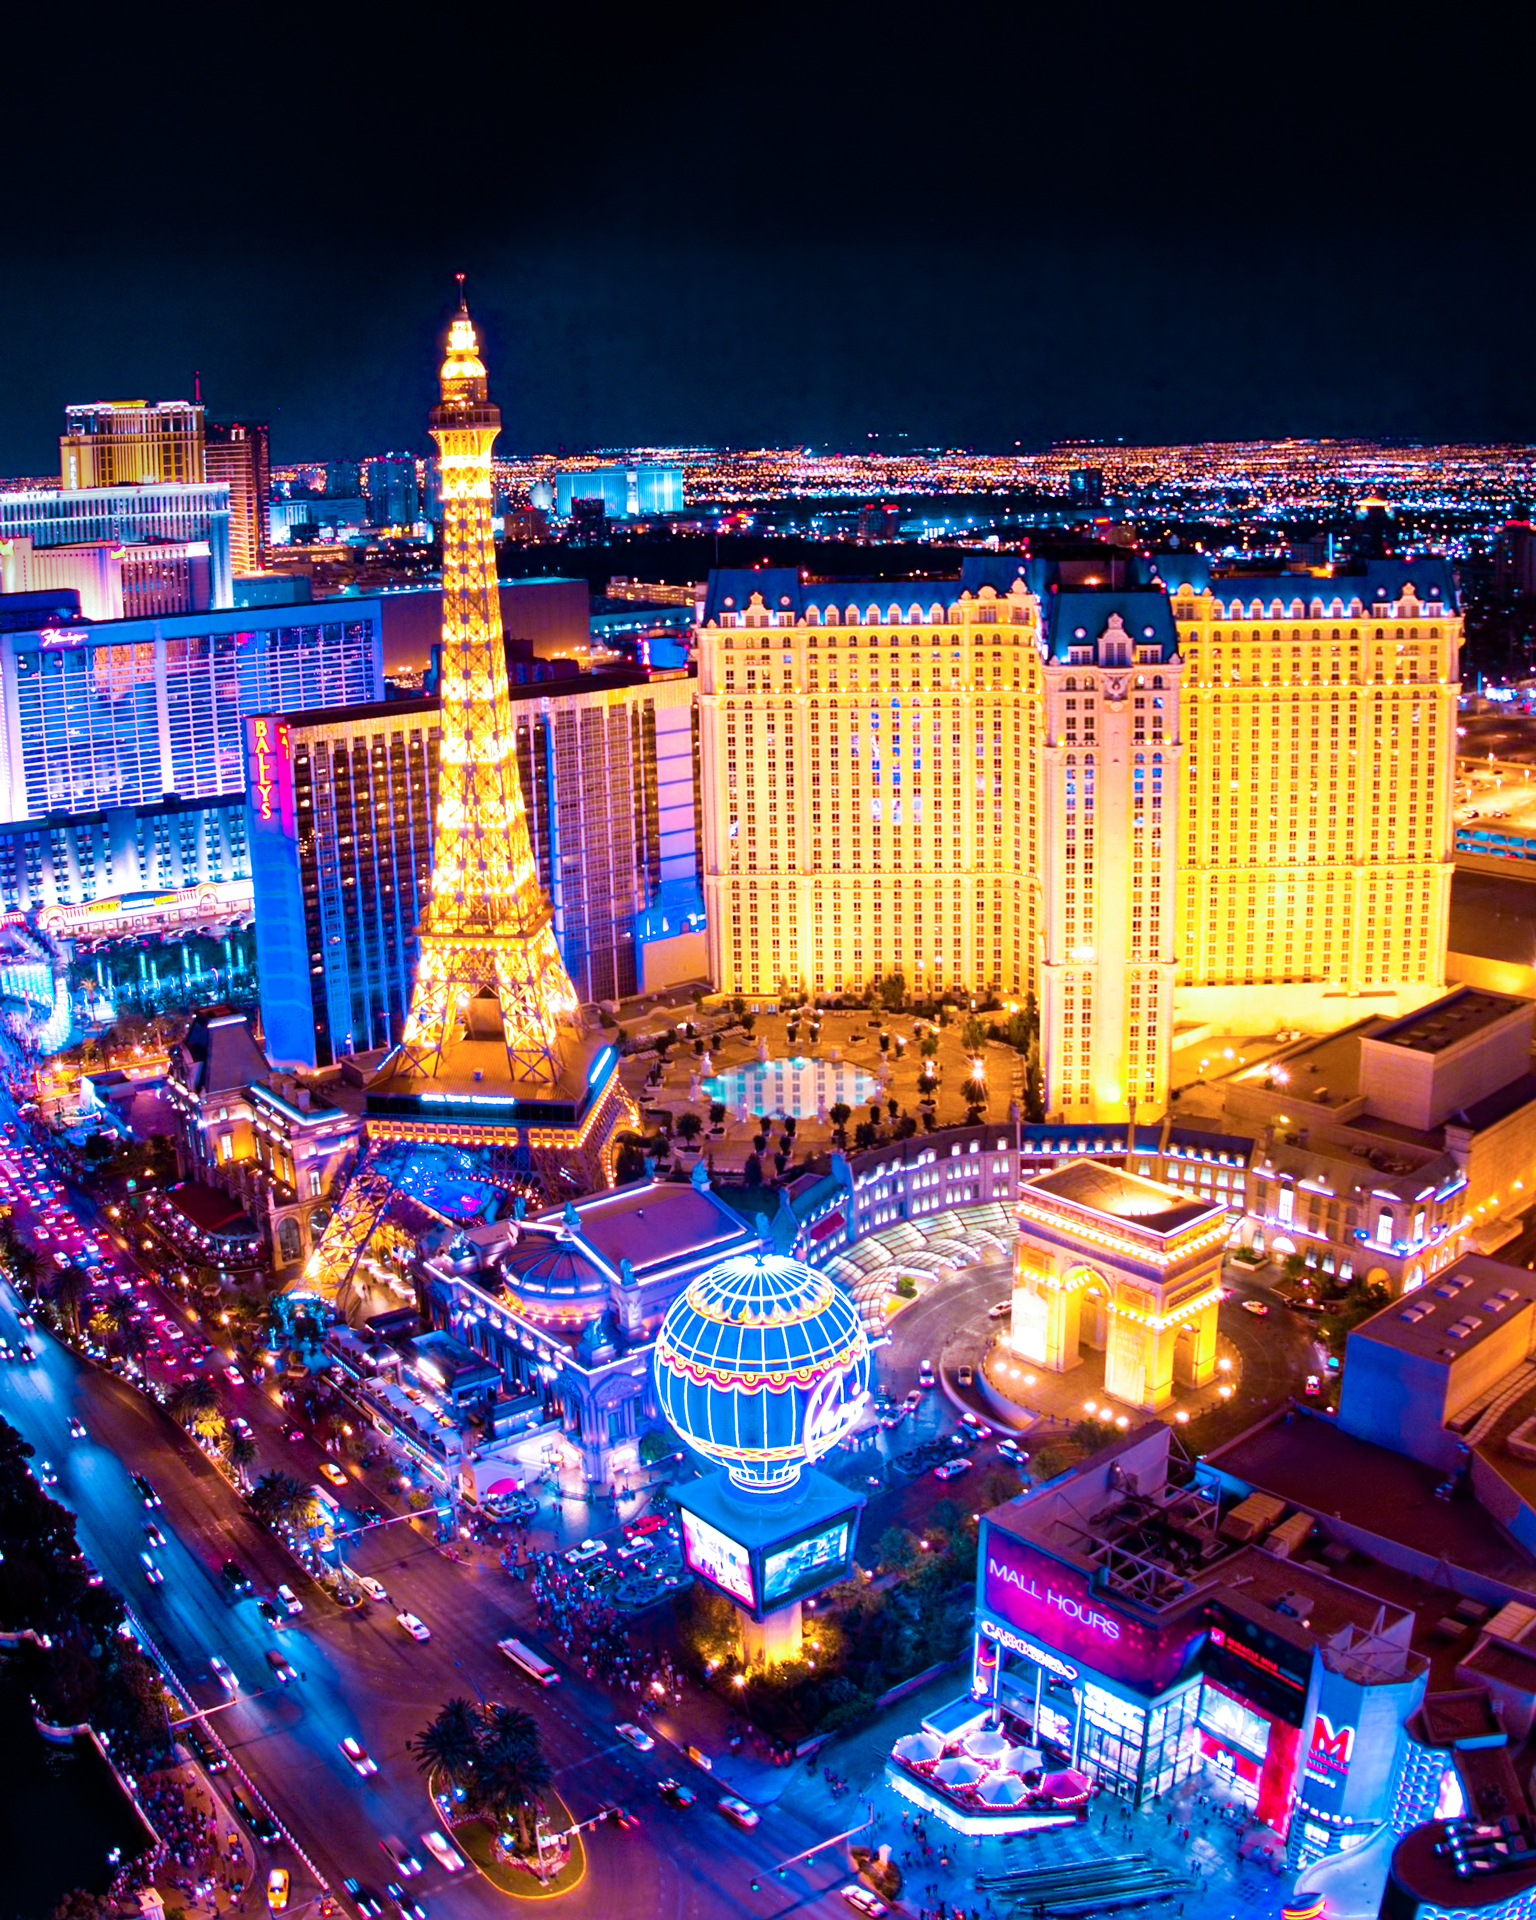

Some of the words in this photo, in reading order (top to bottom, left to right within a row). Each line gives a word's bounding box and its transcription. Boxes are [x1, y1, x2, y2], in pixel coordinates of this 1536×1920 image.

[989, 1557, 1043, 1600] MALL
[1046, 1588, 1120, 1639] HOURS
[1310, 1714, 1356, 1764] M
